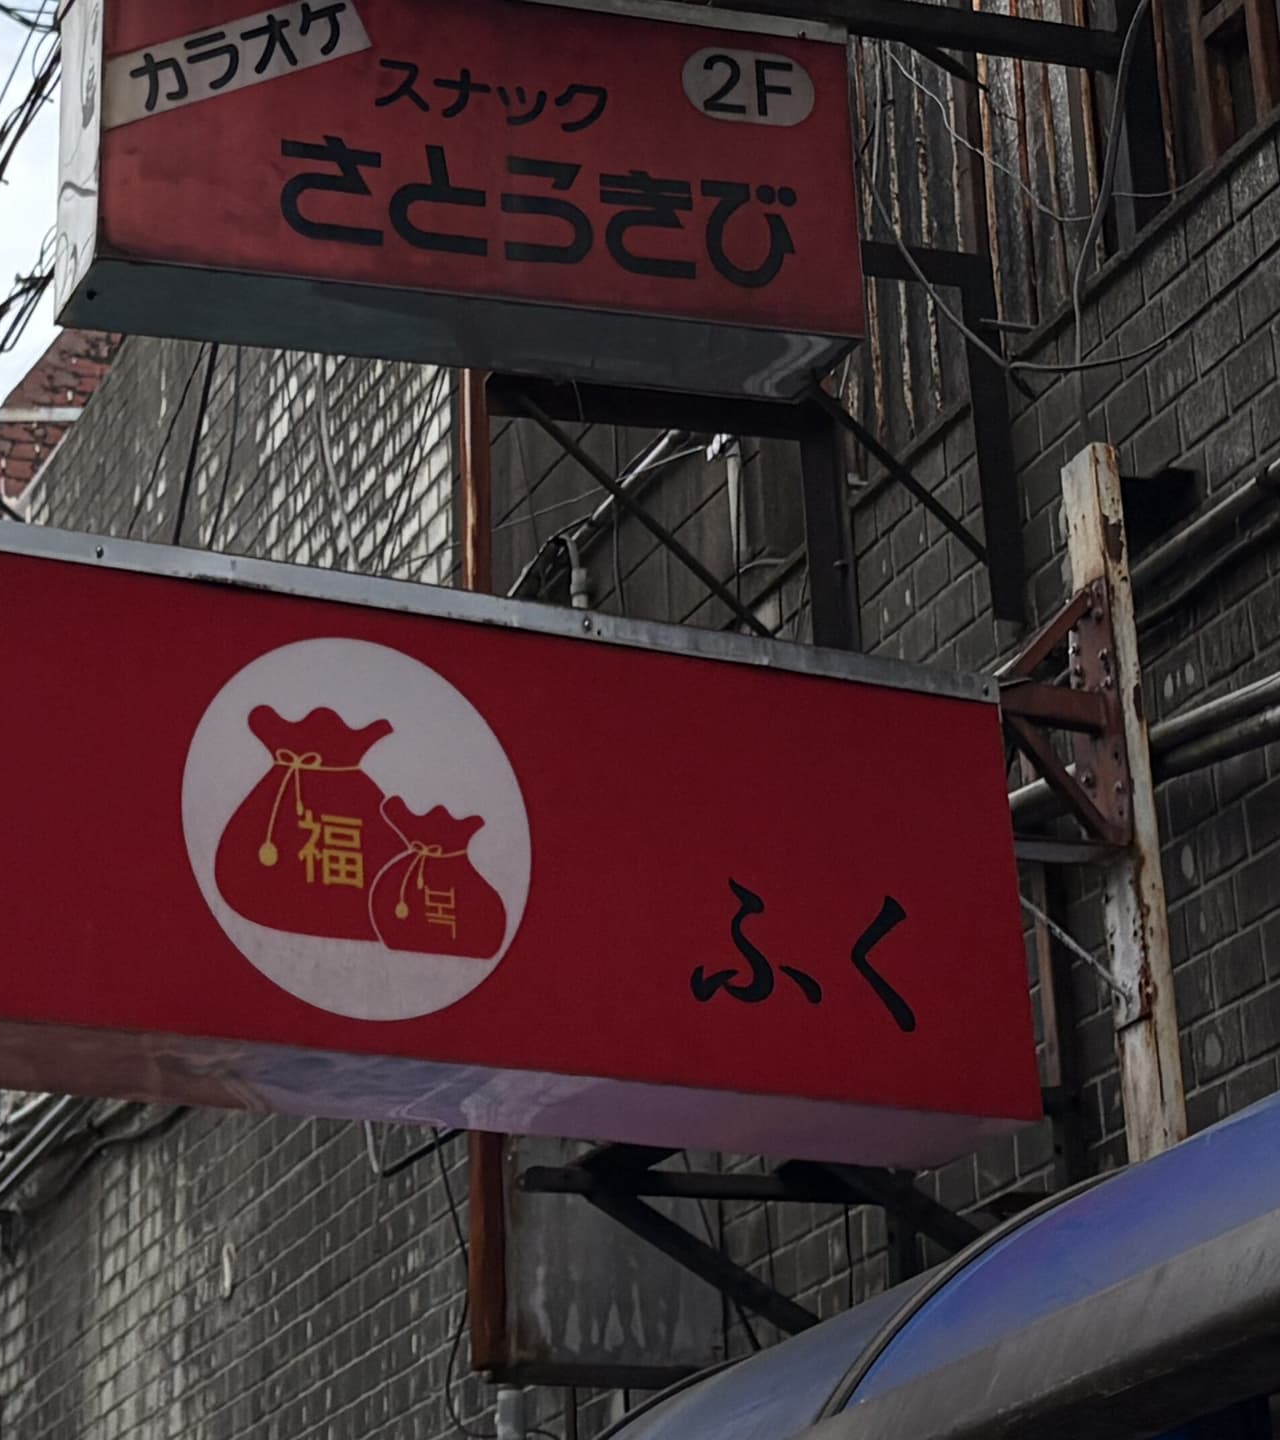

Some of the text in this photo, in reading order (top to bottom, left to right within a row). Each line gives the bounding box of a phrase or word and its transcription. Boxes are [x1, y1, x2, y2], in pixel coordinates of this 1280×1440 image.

[374, 57, 608, 133] スナック
[702, 53, 793, 116] 2F
[279, 134, 798, 289] さとうきび
[297, 809, 365, 889] 福
[689, 878, 917, 1033] ふく
